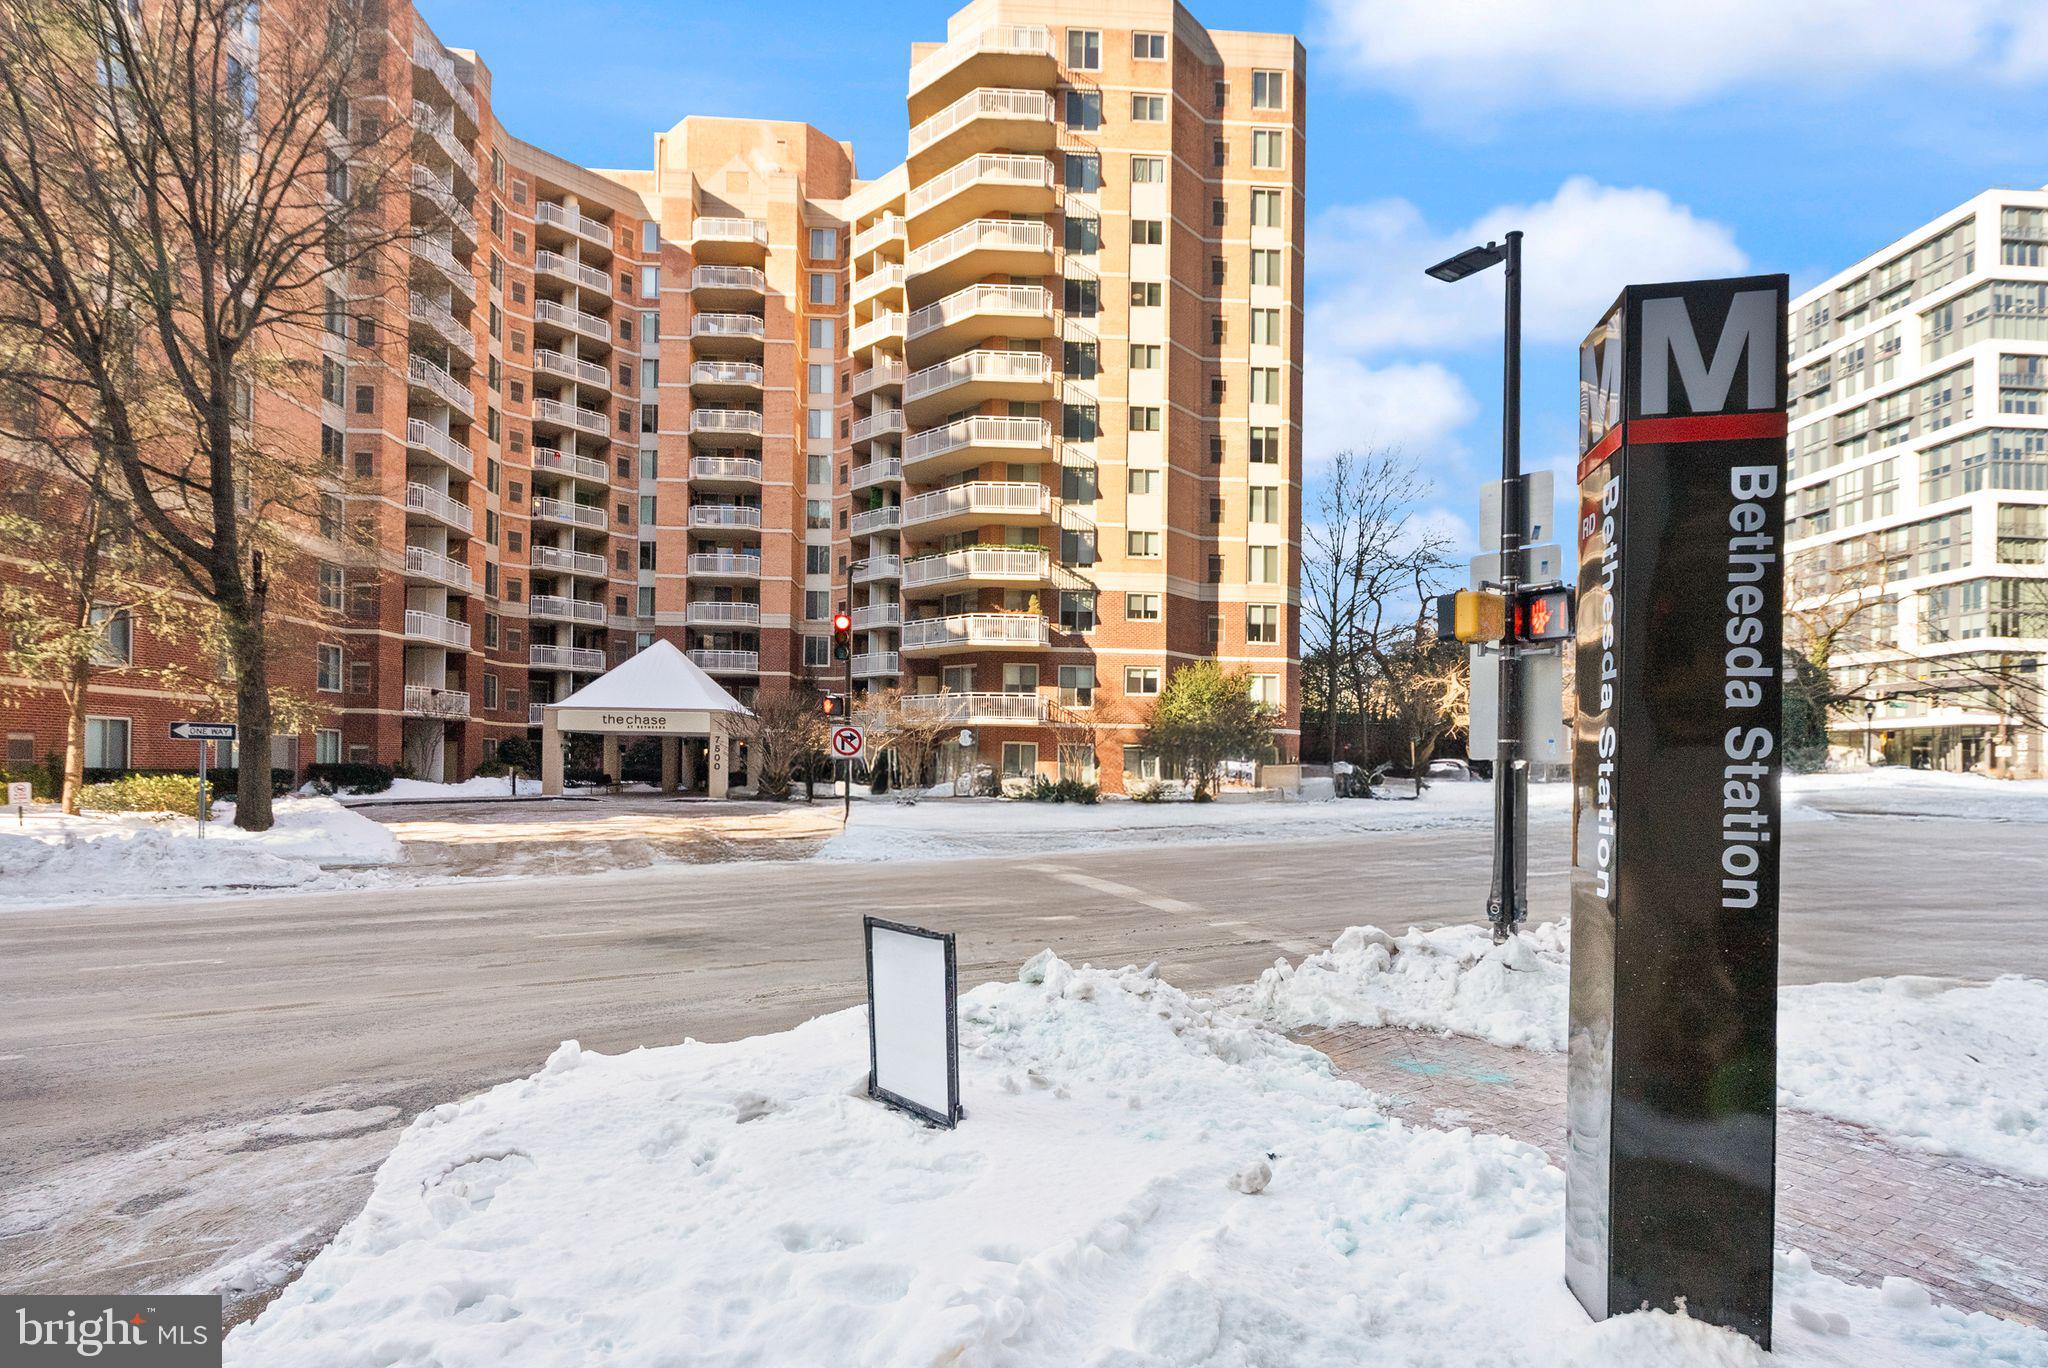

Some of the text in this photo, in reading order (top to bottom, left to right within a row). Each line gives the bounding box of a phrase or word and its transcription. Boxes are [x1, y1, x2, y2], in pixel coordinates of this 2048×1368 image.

[1641, 289, 1778, 416] M
[1582, 512, 1596, 541] RD
[602, 714, 667, 725] the chase
[1597, 475, 1619, 898] Bethesda Station
[1722, 464, 1778, 908] Bethesda Station
[189, 727, 229, 736] ONE WAY
